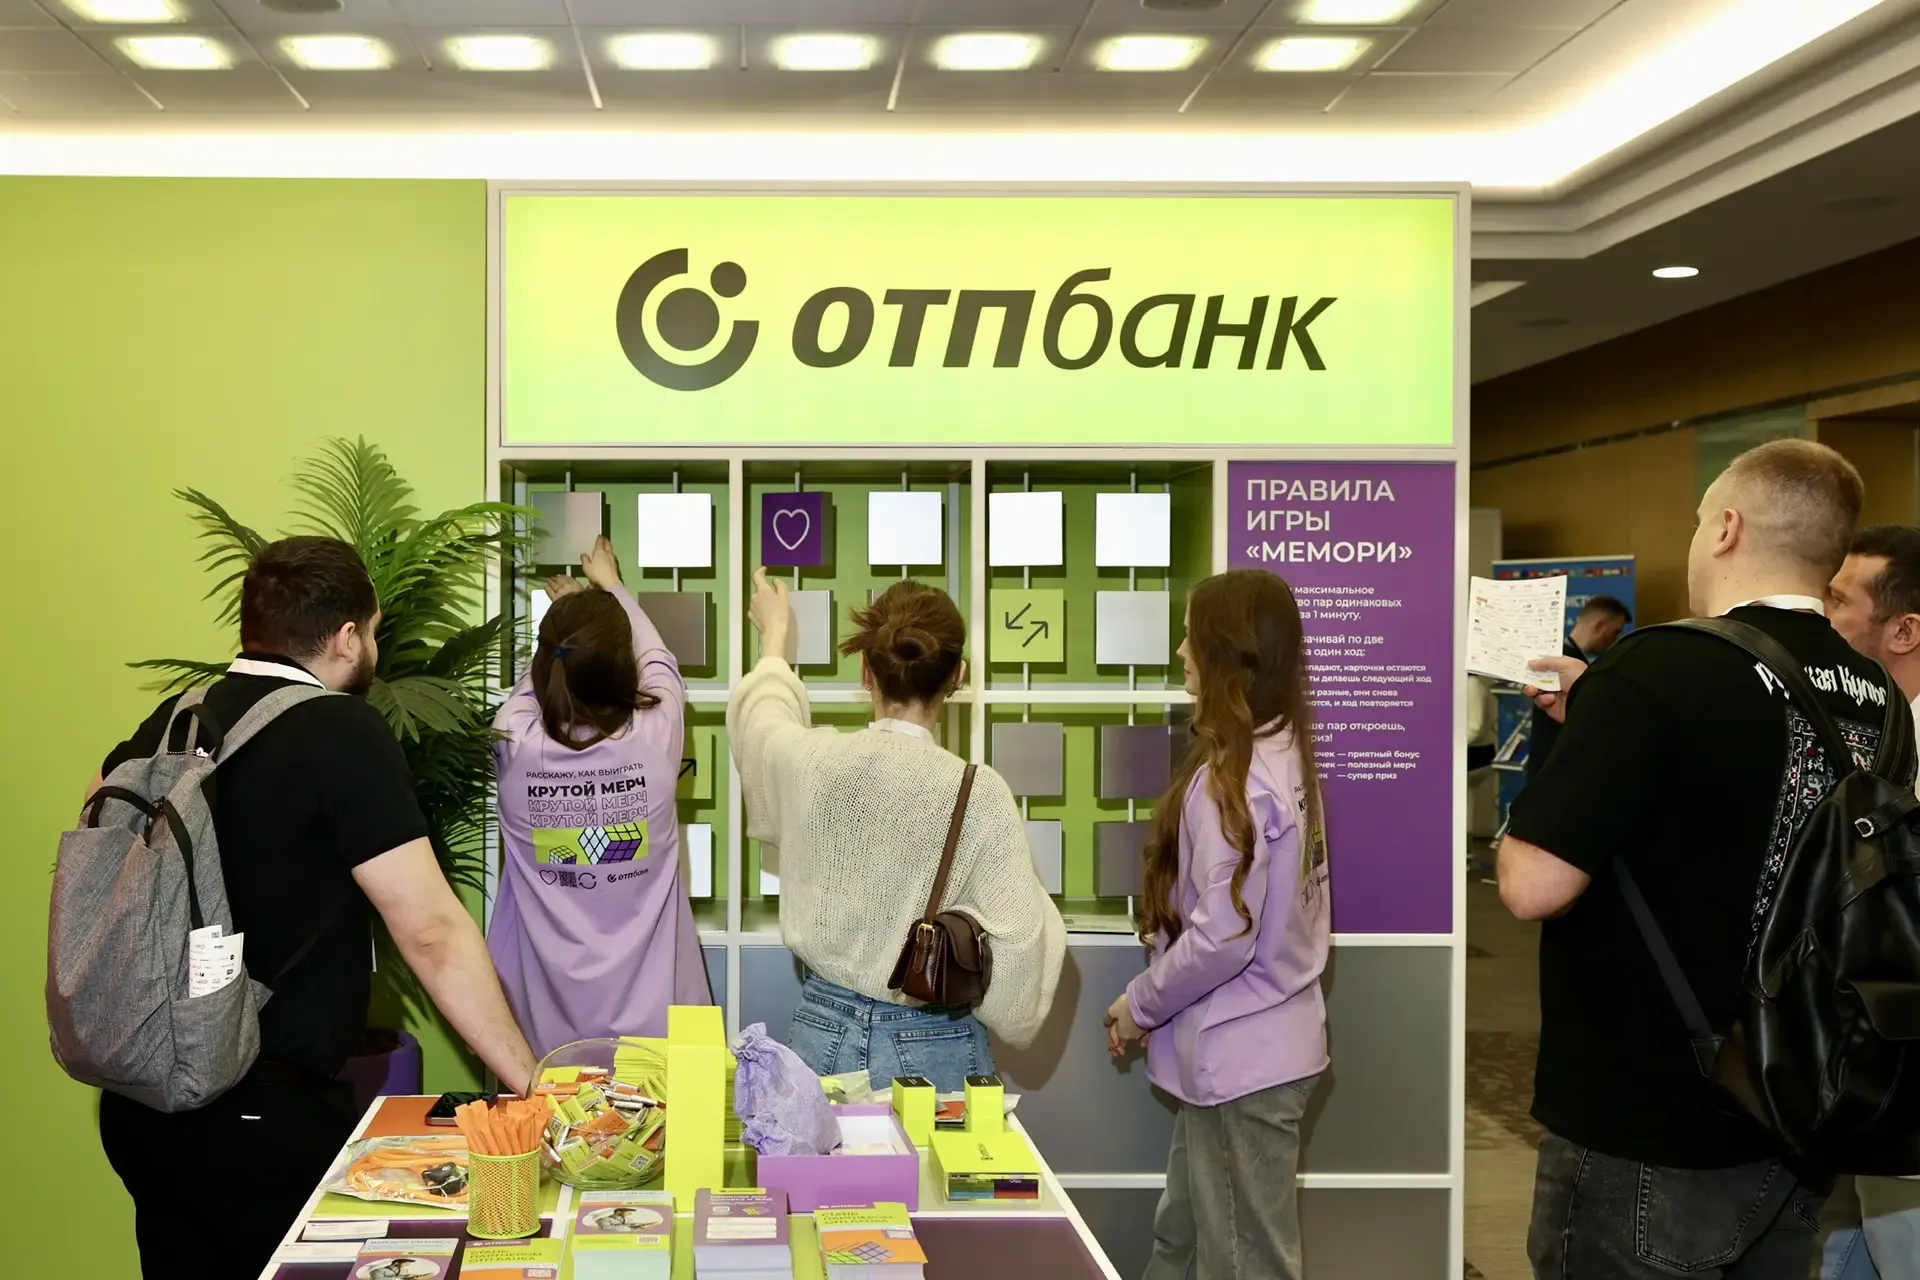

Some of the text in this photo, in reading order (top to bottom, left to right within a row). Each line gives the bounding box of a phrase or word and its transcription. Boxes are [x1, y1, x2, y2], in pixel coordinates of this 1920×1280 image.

[1247, 479, 1395, 502] ПРАВИЛА
[1246, 510, 1330, 532] ИГРЫ
[1246, 541, 1413, 563] «МЕМОРИ»
[1295, 586, 1375, 595] максимальное
[1313, 599, 1333, 609] пар
[1335, 599, 1402, 609] одинаковых
[1313, 611, 1318, 620] 1
[1320, 611, 1362, 621] минуту.
[1348, 636, 1362, 645] по
[1364, 636, 1384, 646] две
[1314, 648, 1342, 658] один
[1344, 648, 1366, 658] ход:
[1305, 664, 1343, 673] падают,
[1344, 665, 1384, 673] карточки
[1309, 675, 1432, 684] ты делаешь следующий ход
[1317, 689, 1352, 698] разные,
[1353, 689, 1370, 697] они
[1372, 689, 1398, 697] снова
[1341, 700, 1358, 709] ход
[1359, 700, 1414, 709] повторяется
[1327, 722, 1348, 732] пар
[1349, 722, 1406, 733] откроешь,
[1310, 733, 1333, 744] риз!
[1347, 750, 1392, 760] приятный
[1393, 750, 1421, 760] бонус
[1347, 760, 1392, 770] полезный
[1393, 762, 1417, 770] мерч
[526, 762, 644, 780] РАССКАЖУ, КАК ВЫИГРАТЬ
[1347, 772, 1374, 781] супер
[1375, 772, 1398, 781] приз
[527, 776, 646, 798] КРУТОЙ МЕРЧ
[528, 790, 648, 813] КРУТОЙ МЕРЧ
[529, 805, 649, 828] КРУТОЙ МЕРЧ
